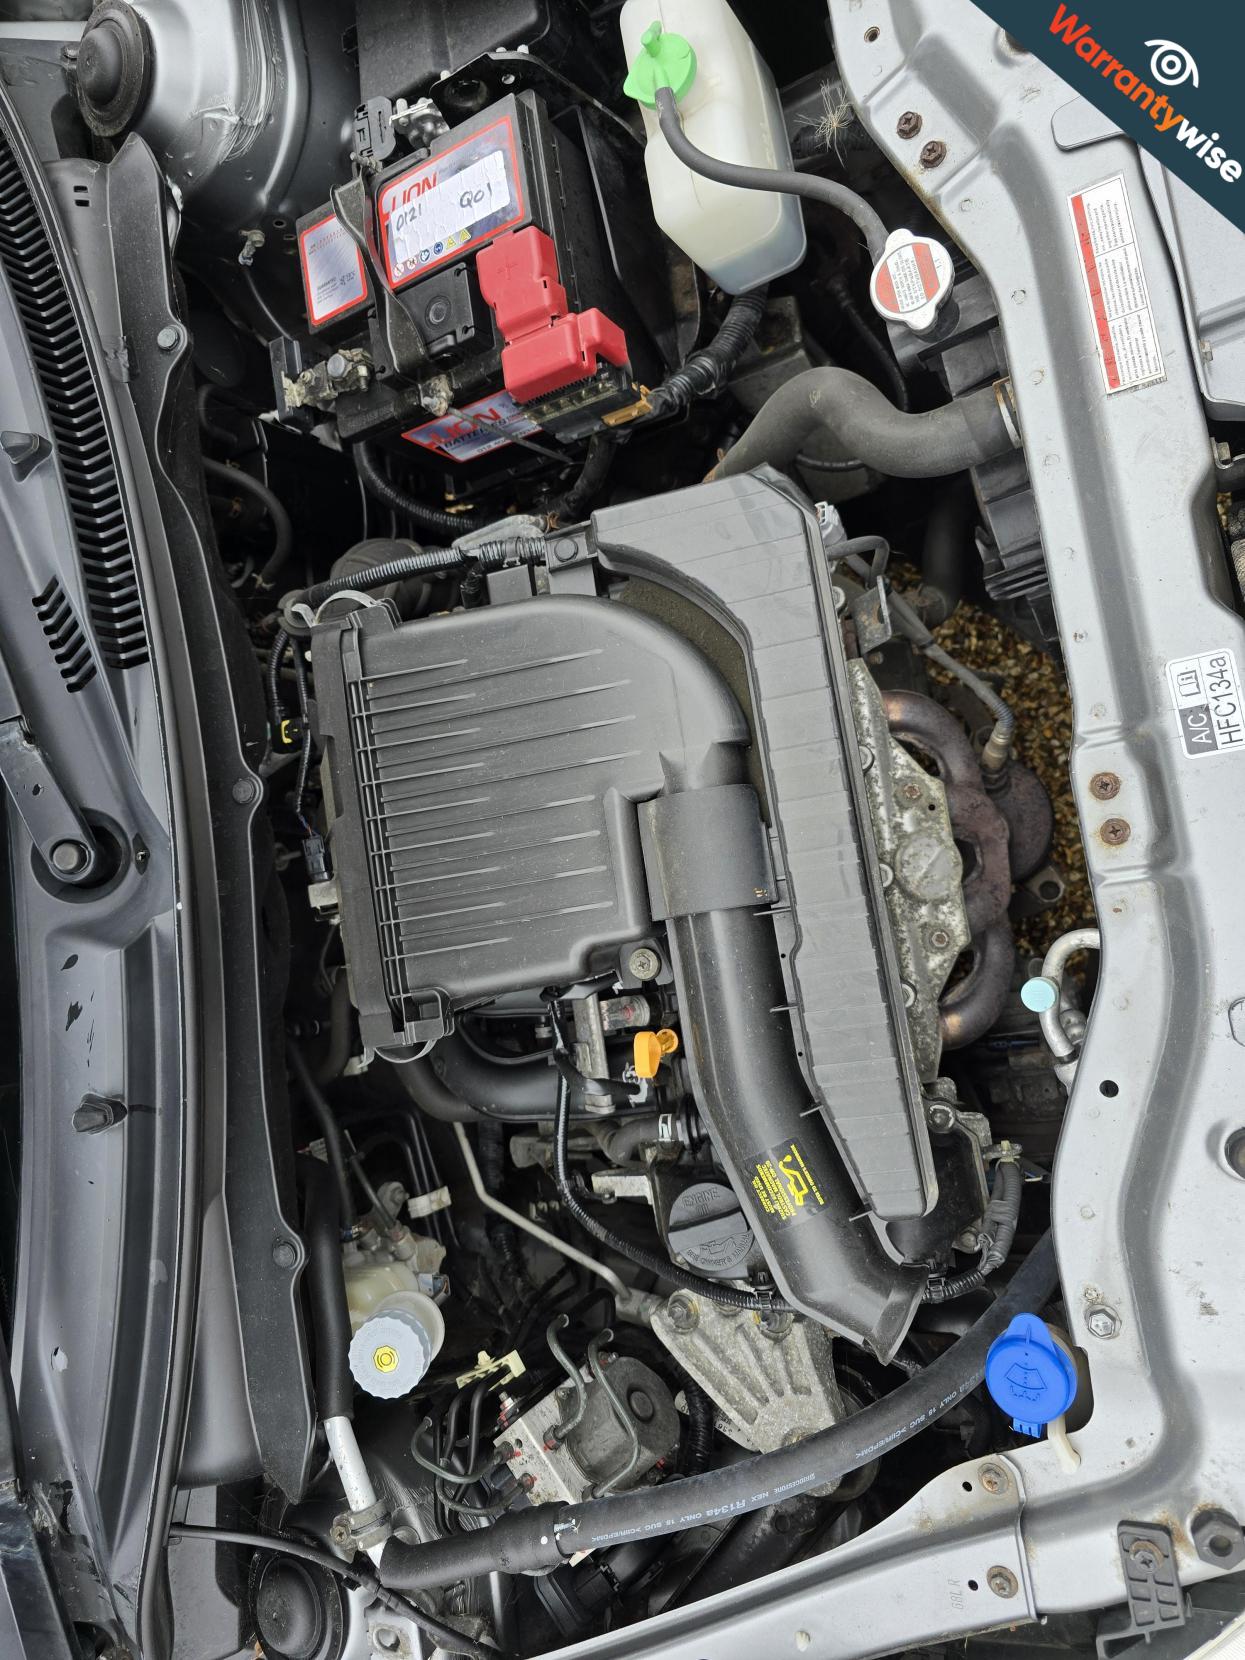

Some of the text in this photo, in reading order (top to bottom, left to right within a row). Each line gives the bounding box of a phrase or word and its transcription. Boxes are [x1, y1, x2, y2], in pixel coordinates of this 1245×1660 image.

[1206, 656, 1244, 745] HFC134a
[682, 1186, 720, 1208] ENGINE
[705, 1499, 746, 1517] R134a
